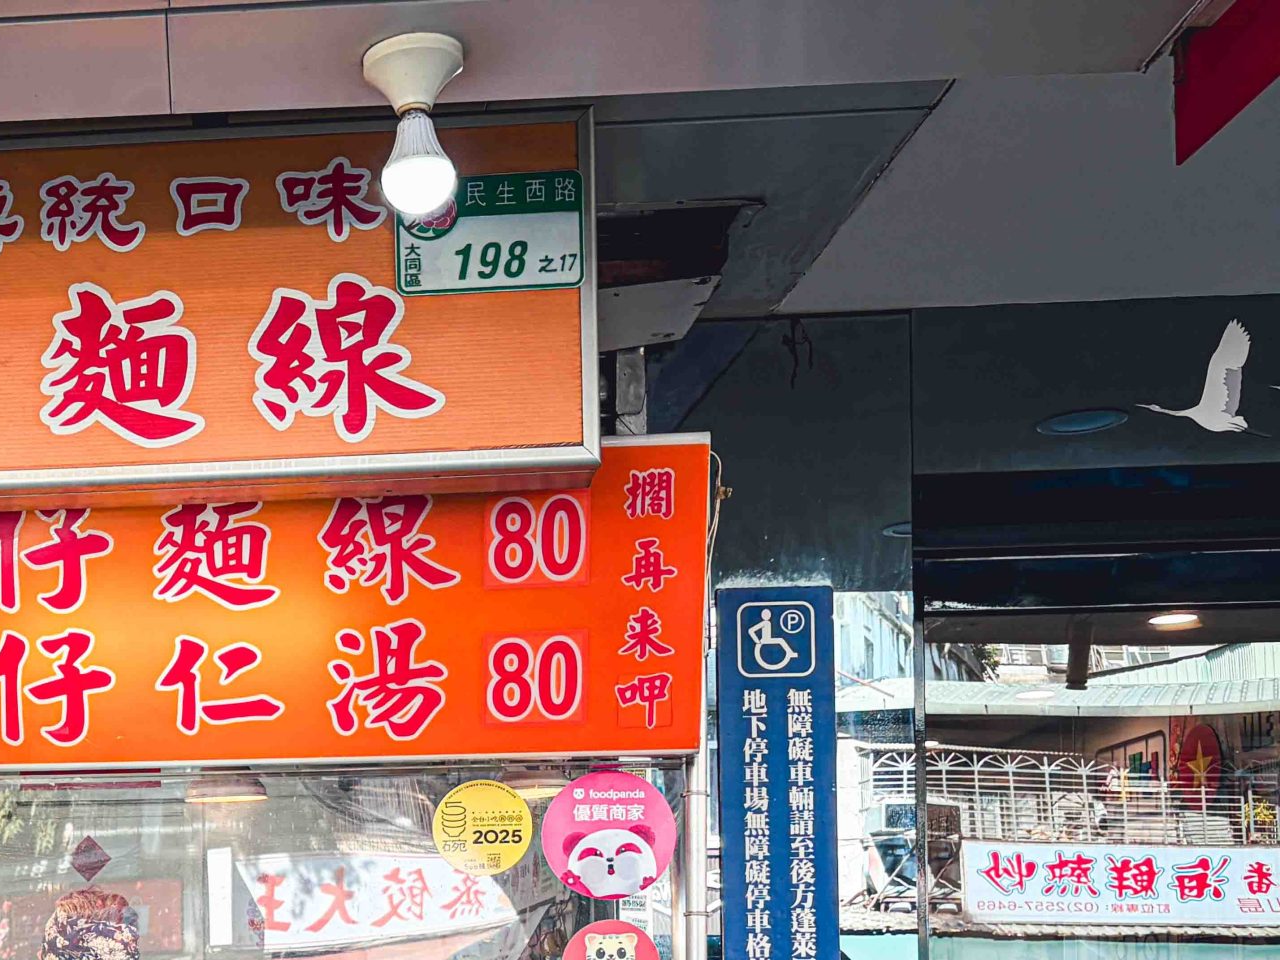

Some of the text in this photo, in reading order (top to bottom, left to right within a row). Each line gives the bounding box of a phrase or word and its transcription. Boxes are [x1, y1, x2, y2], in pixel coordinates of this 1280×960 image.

[465, 177, 576, 207] 民生西路
[404, 242, 423, 288] 大同區
[455, 240, 578, 281] 198 之17
[488, 493, 587, 584] 80
[486, 634, 583, 723] 80
[588, 788, 646, 800] foodpanda
[572, 803, 645, 822] 優質商家
[472, 829, 523, 845] 2025
